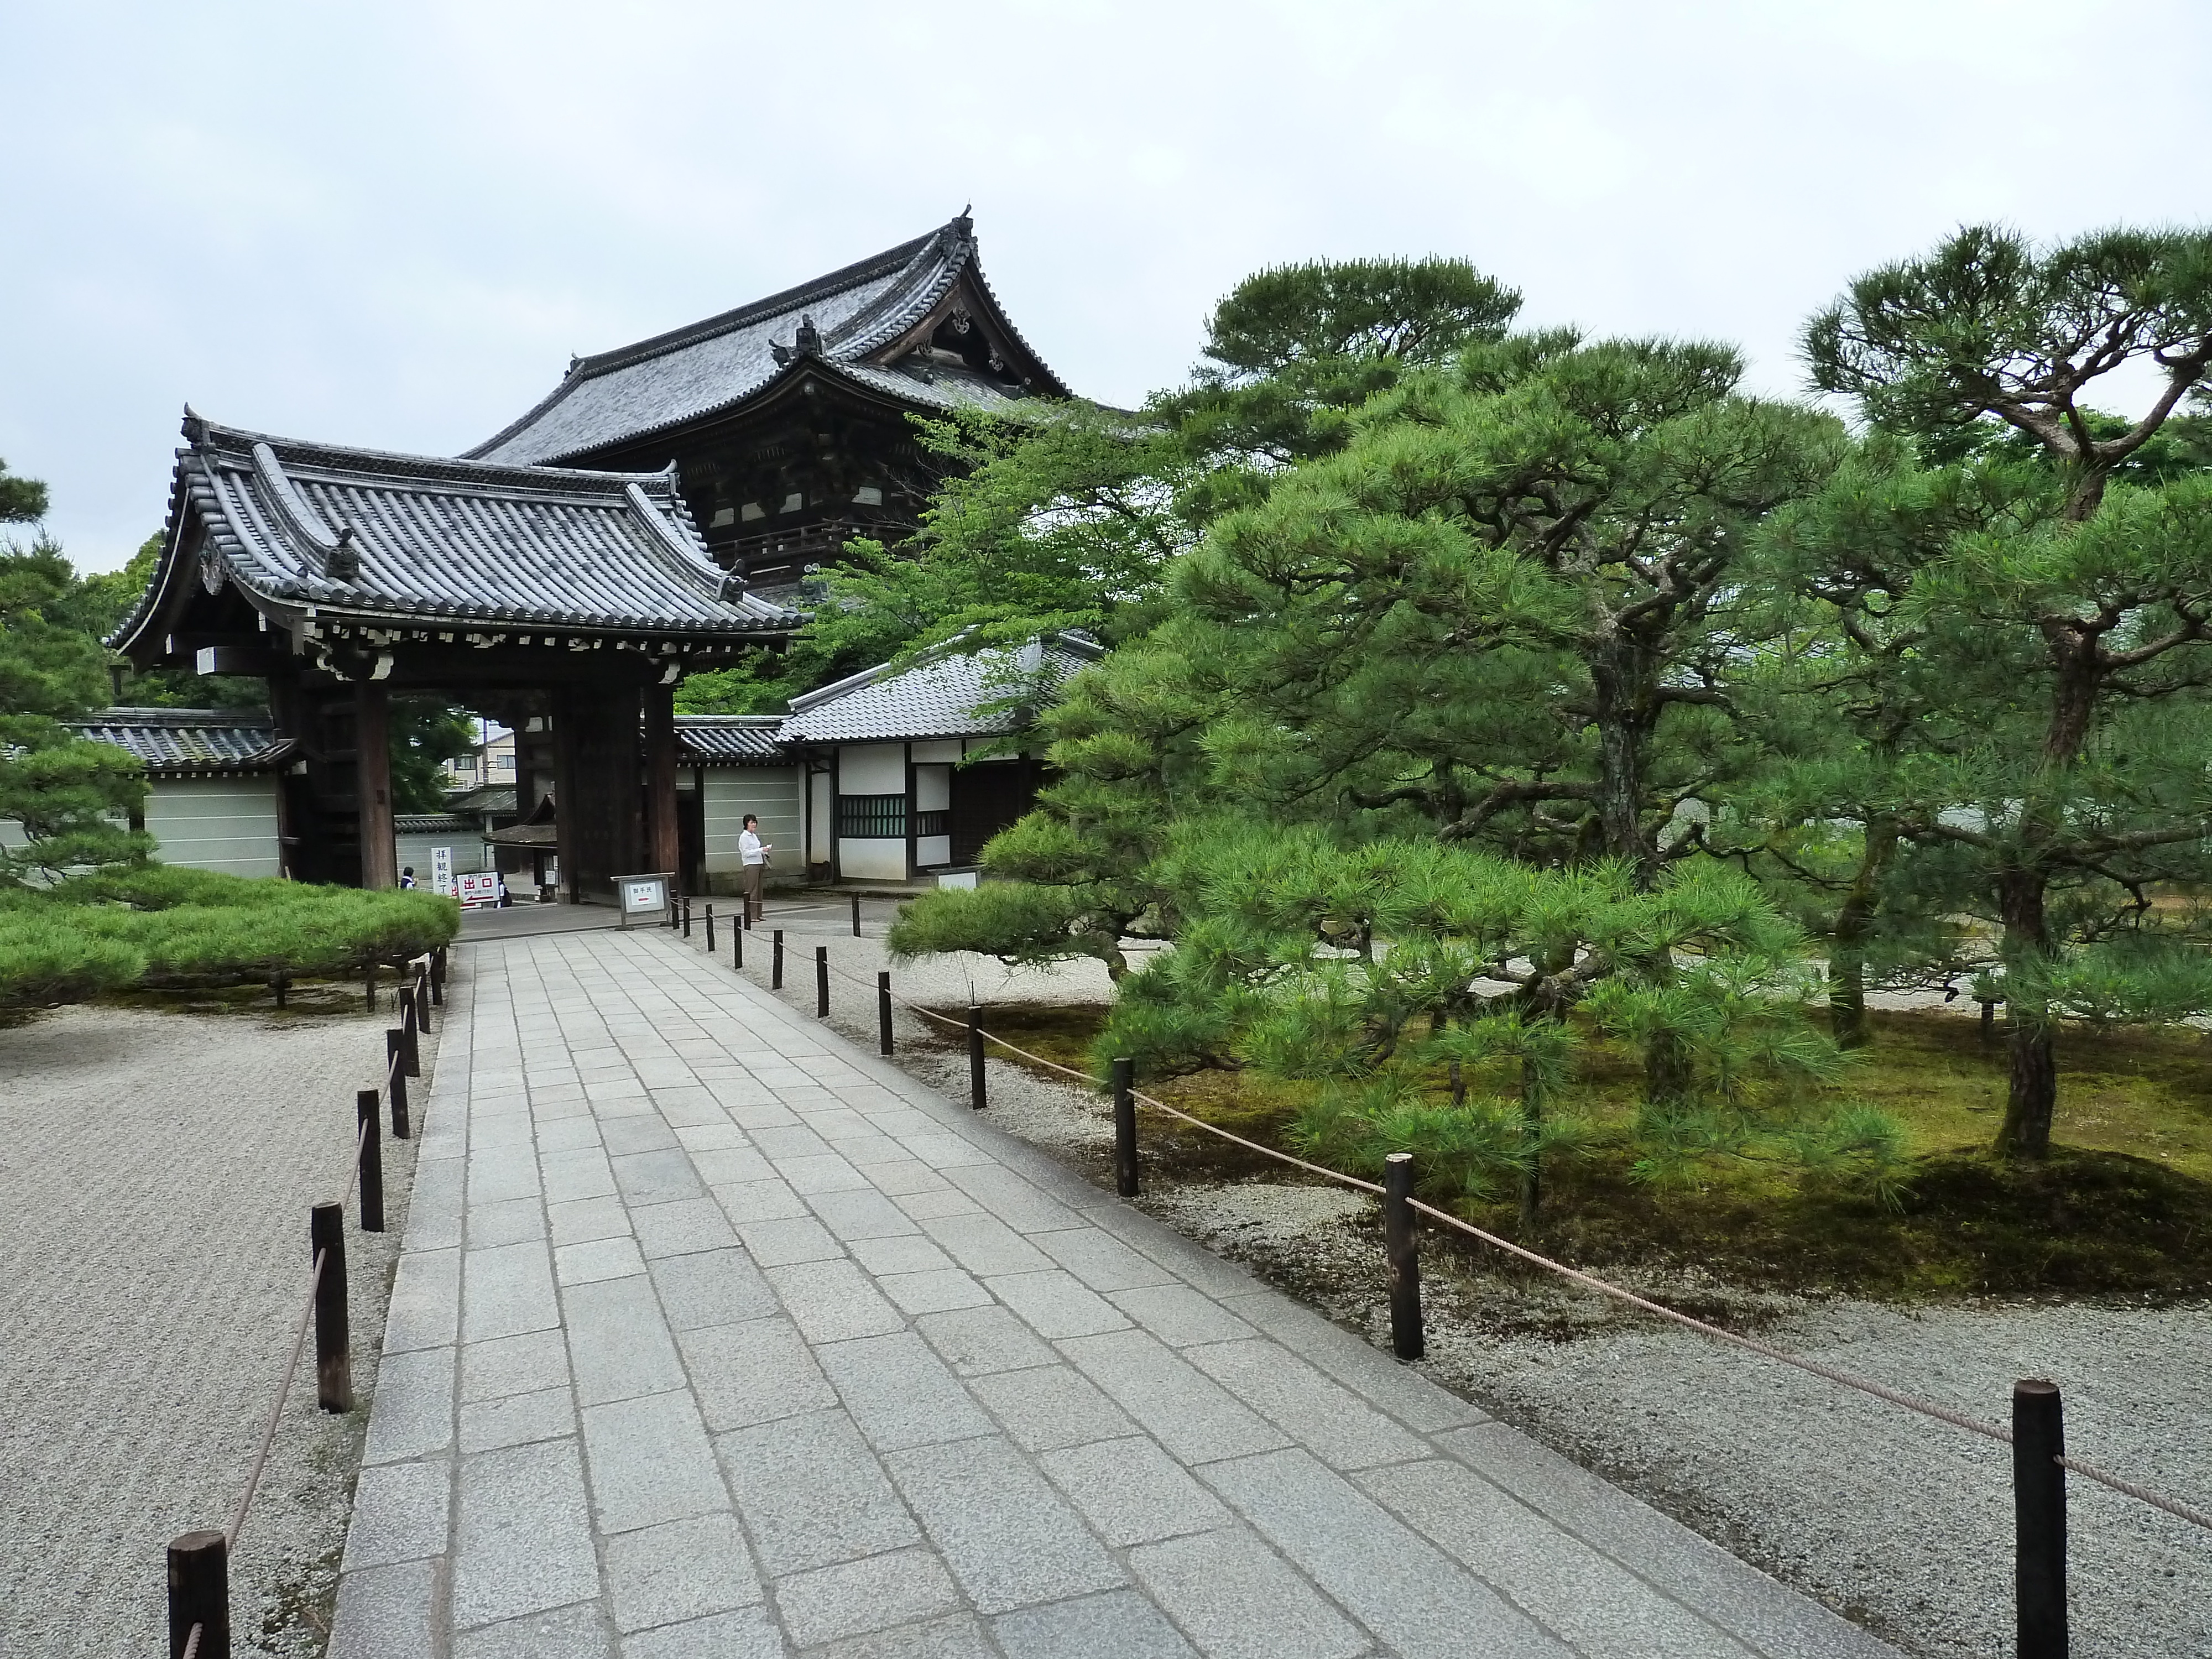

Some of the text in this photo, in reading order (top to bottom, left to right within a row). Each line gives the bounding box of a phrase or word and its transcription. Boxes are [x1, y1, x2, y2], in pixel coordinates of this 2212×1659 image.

[464, 878, 492, 890] 出口
[633, 886, 653, 894] 御手洗
